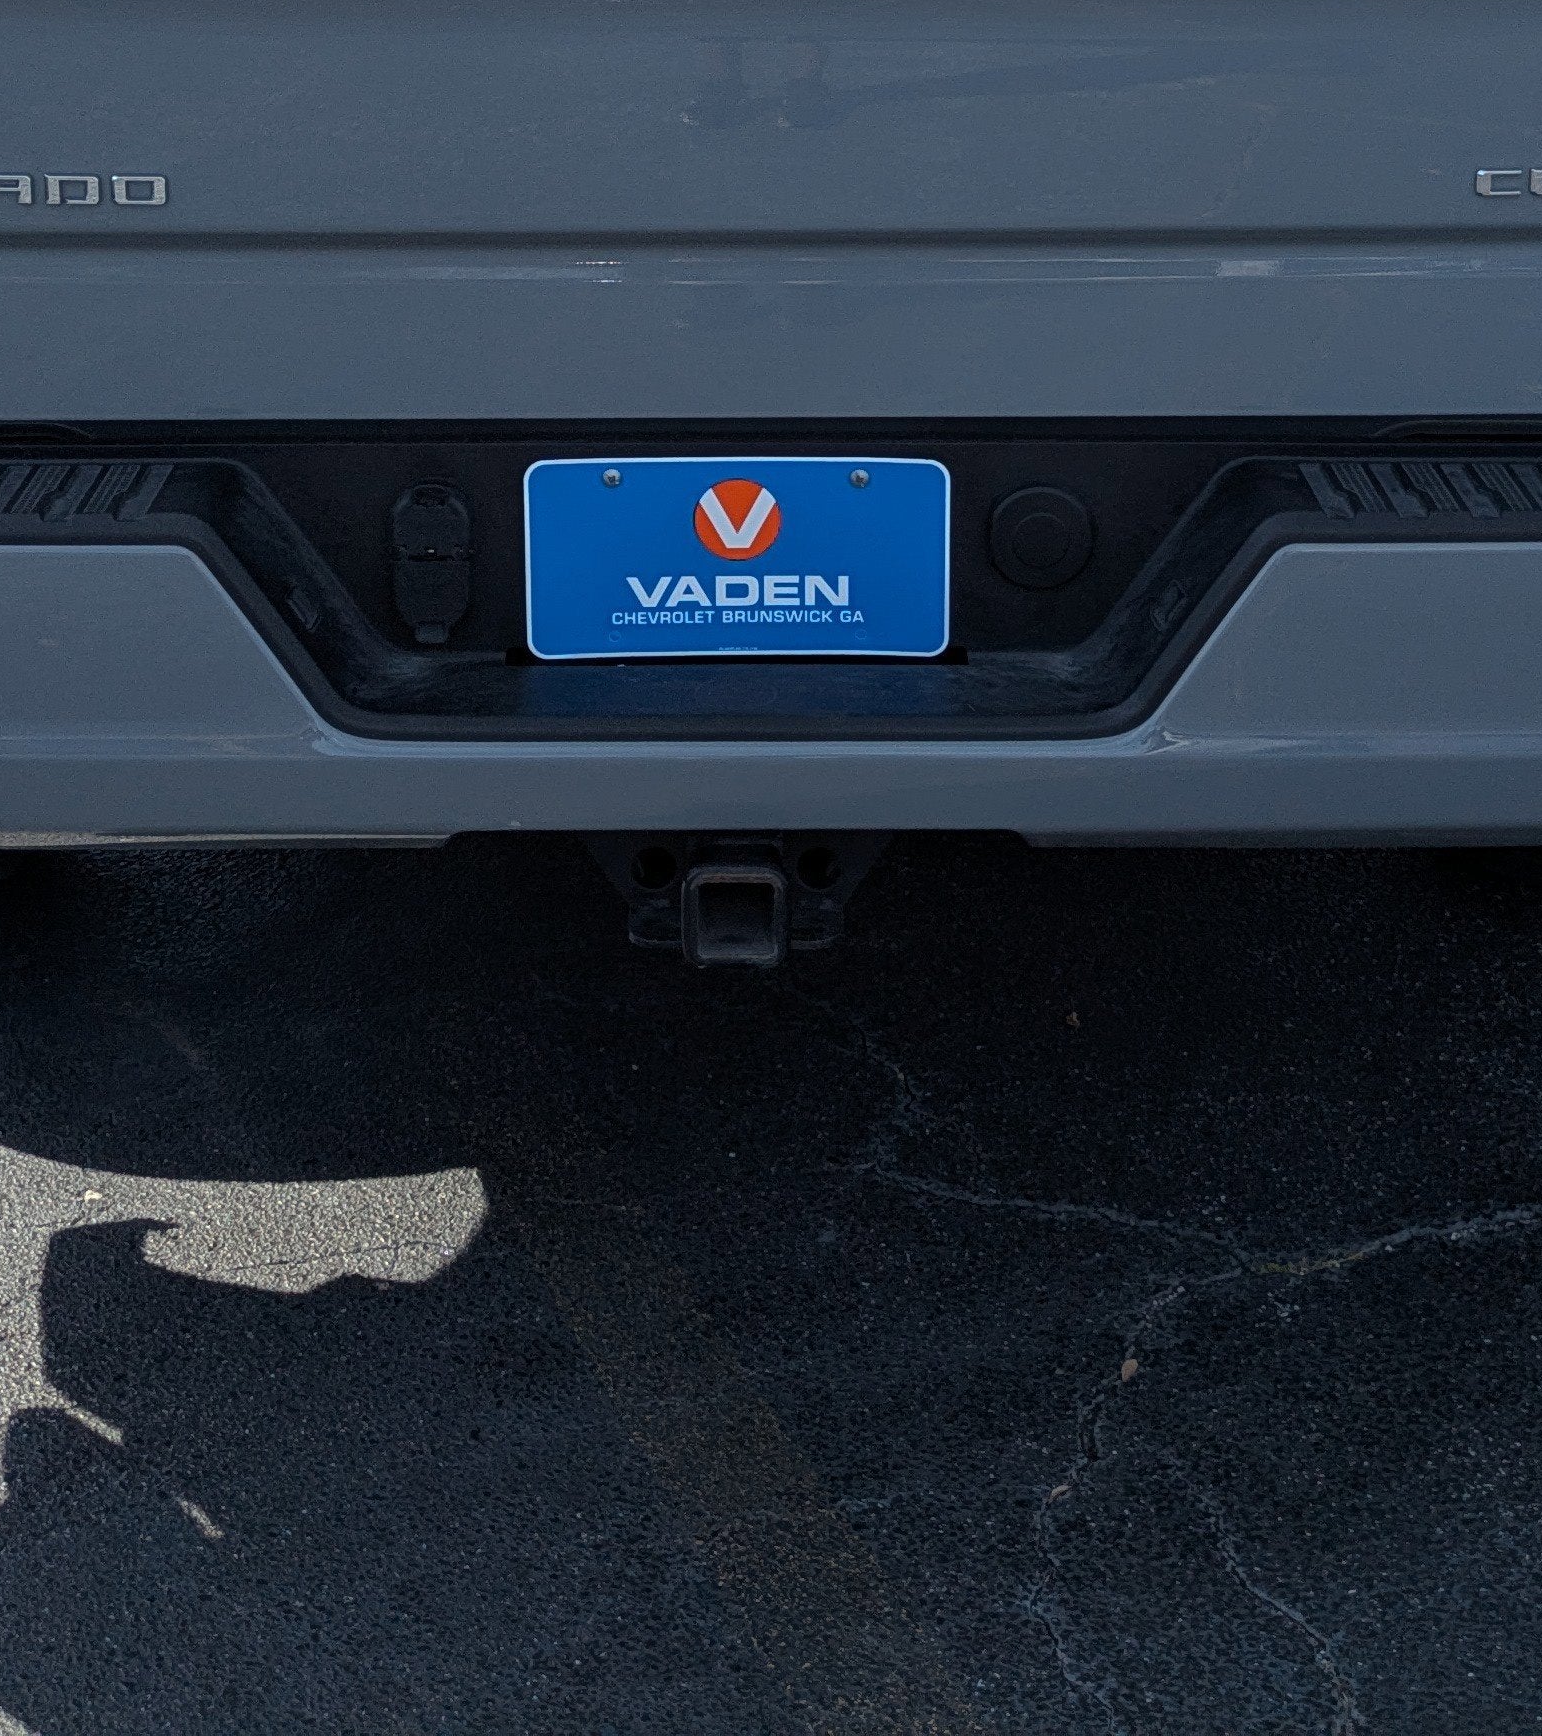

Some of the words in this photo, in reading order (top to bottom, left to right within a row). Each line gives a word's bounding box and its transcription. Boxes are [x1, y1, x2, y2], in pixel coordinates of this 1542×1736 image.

[625, 575, 850, 608] VADEN
[611, 610, 716, 625] CHEVROLET
[722, 609, 833, 624] BRUNSWICK
[839, 609, 865, 624] GA
